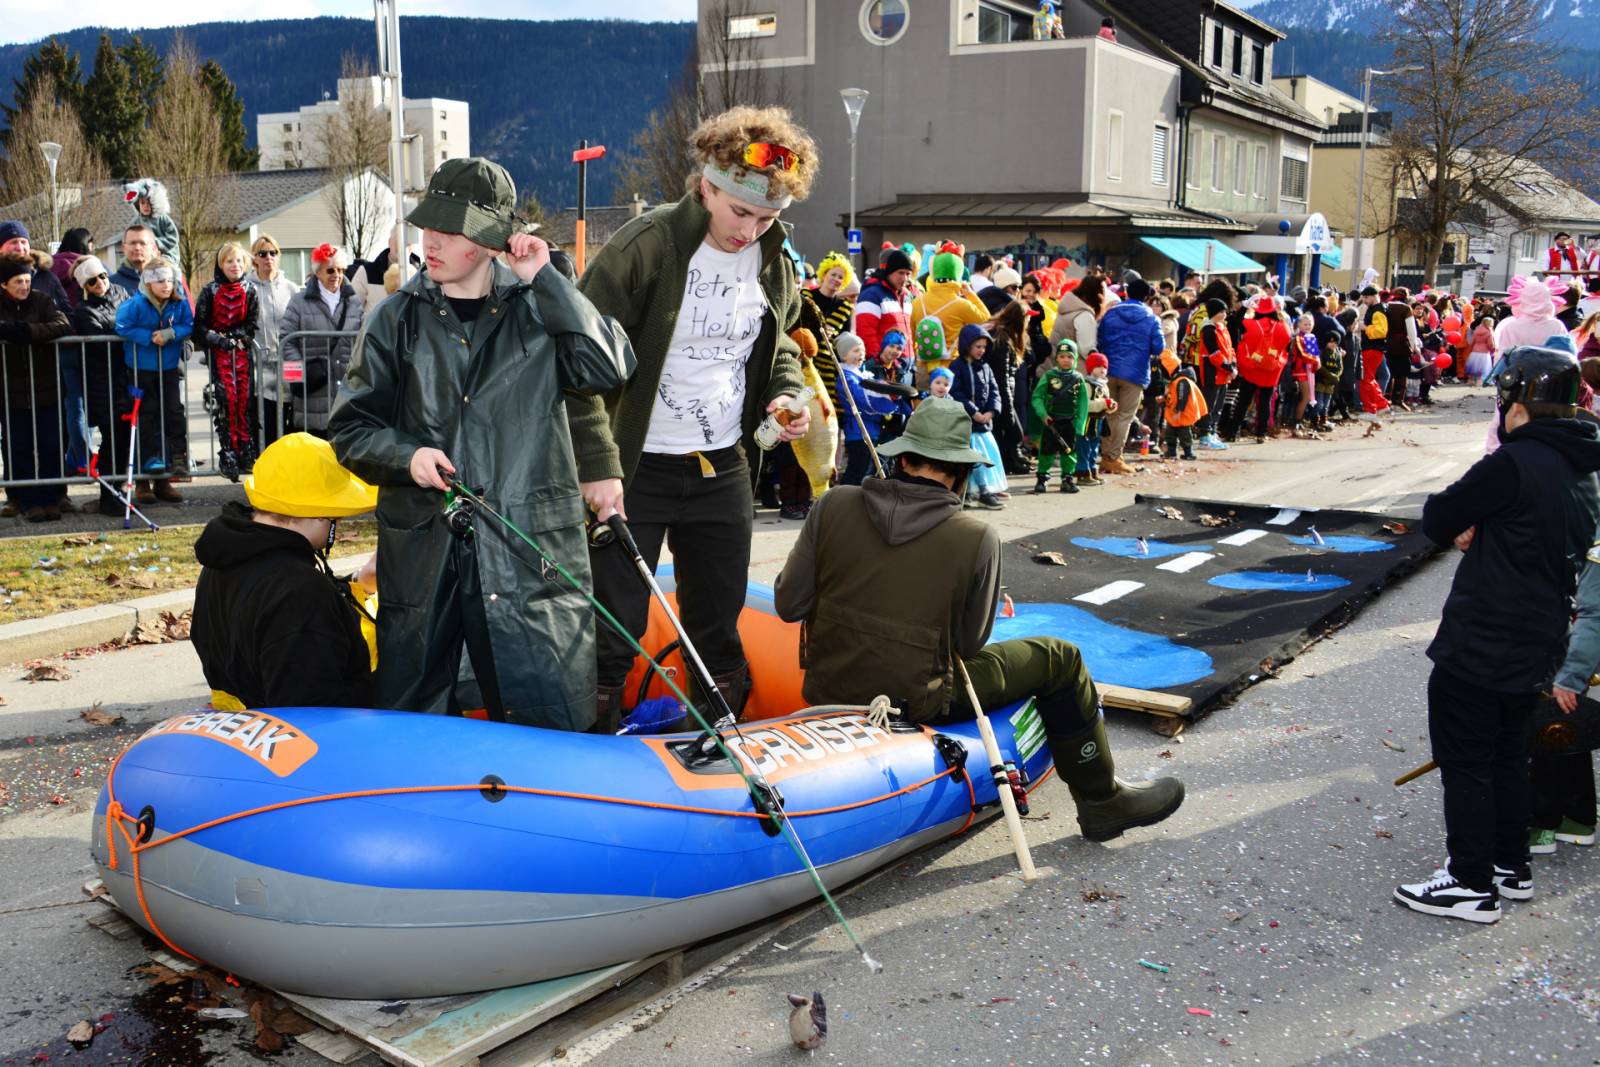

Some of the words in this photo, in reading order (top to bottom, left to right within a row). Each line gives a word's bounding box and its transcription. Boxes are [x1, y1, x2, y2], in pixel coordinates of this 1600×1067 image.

[688, 268, 742, 299] Petri
[682, 345, 736, 361] 2025
[725, 714, 892, 776] CRUISER
